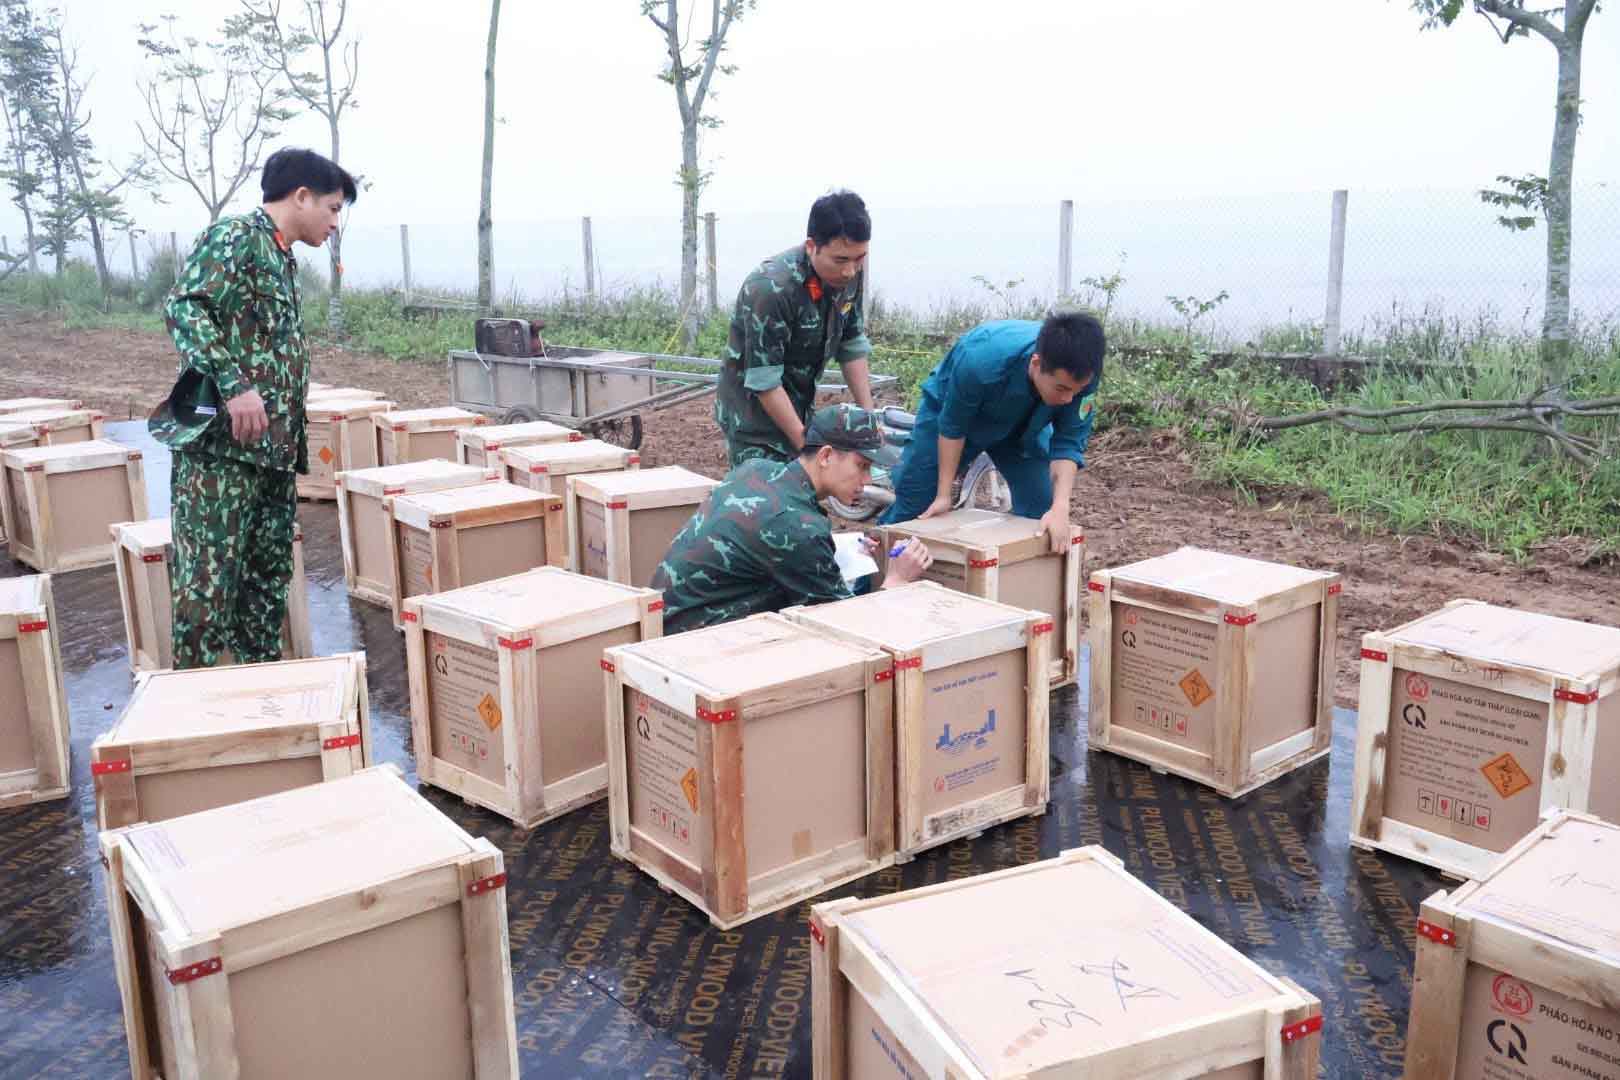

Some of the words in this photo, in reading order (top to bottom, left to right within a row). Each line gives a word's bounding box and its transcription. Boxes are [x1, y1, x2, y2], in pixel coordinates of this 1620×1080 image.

[1137, 805, 1177, 870] PLYWOOD
[1203, 808, 1248, 873] PLYWOOD
[1228, 875, 1276, 944] VIETNAM
[685, 931, 743, 1025] PLYWOOD
[767, 935, 811, 1033] PLYWOOD
[751, 1033, 795, 1080] VIE
